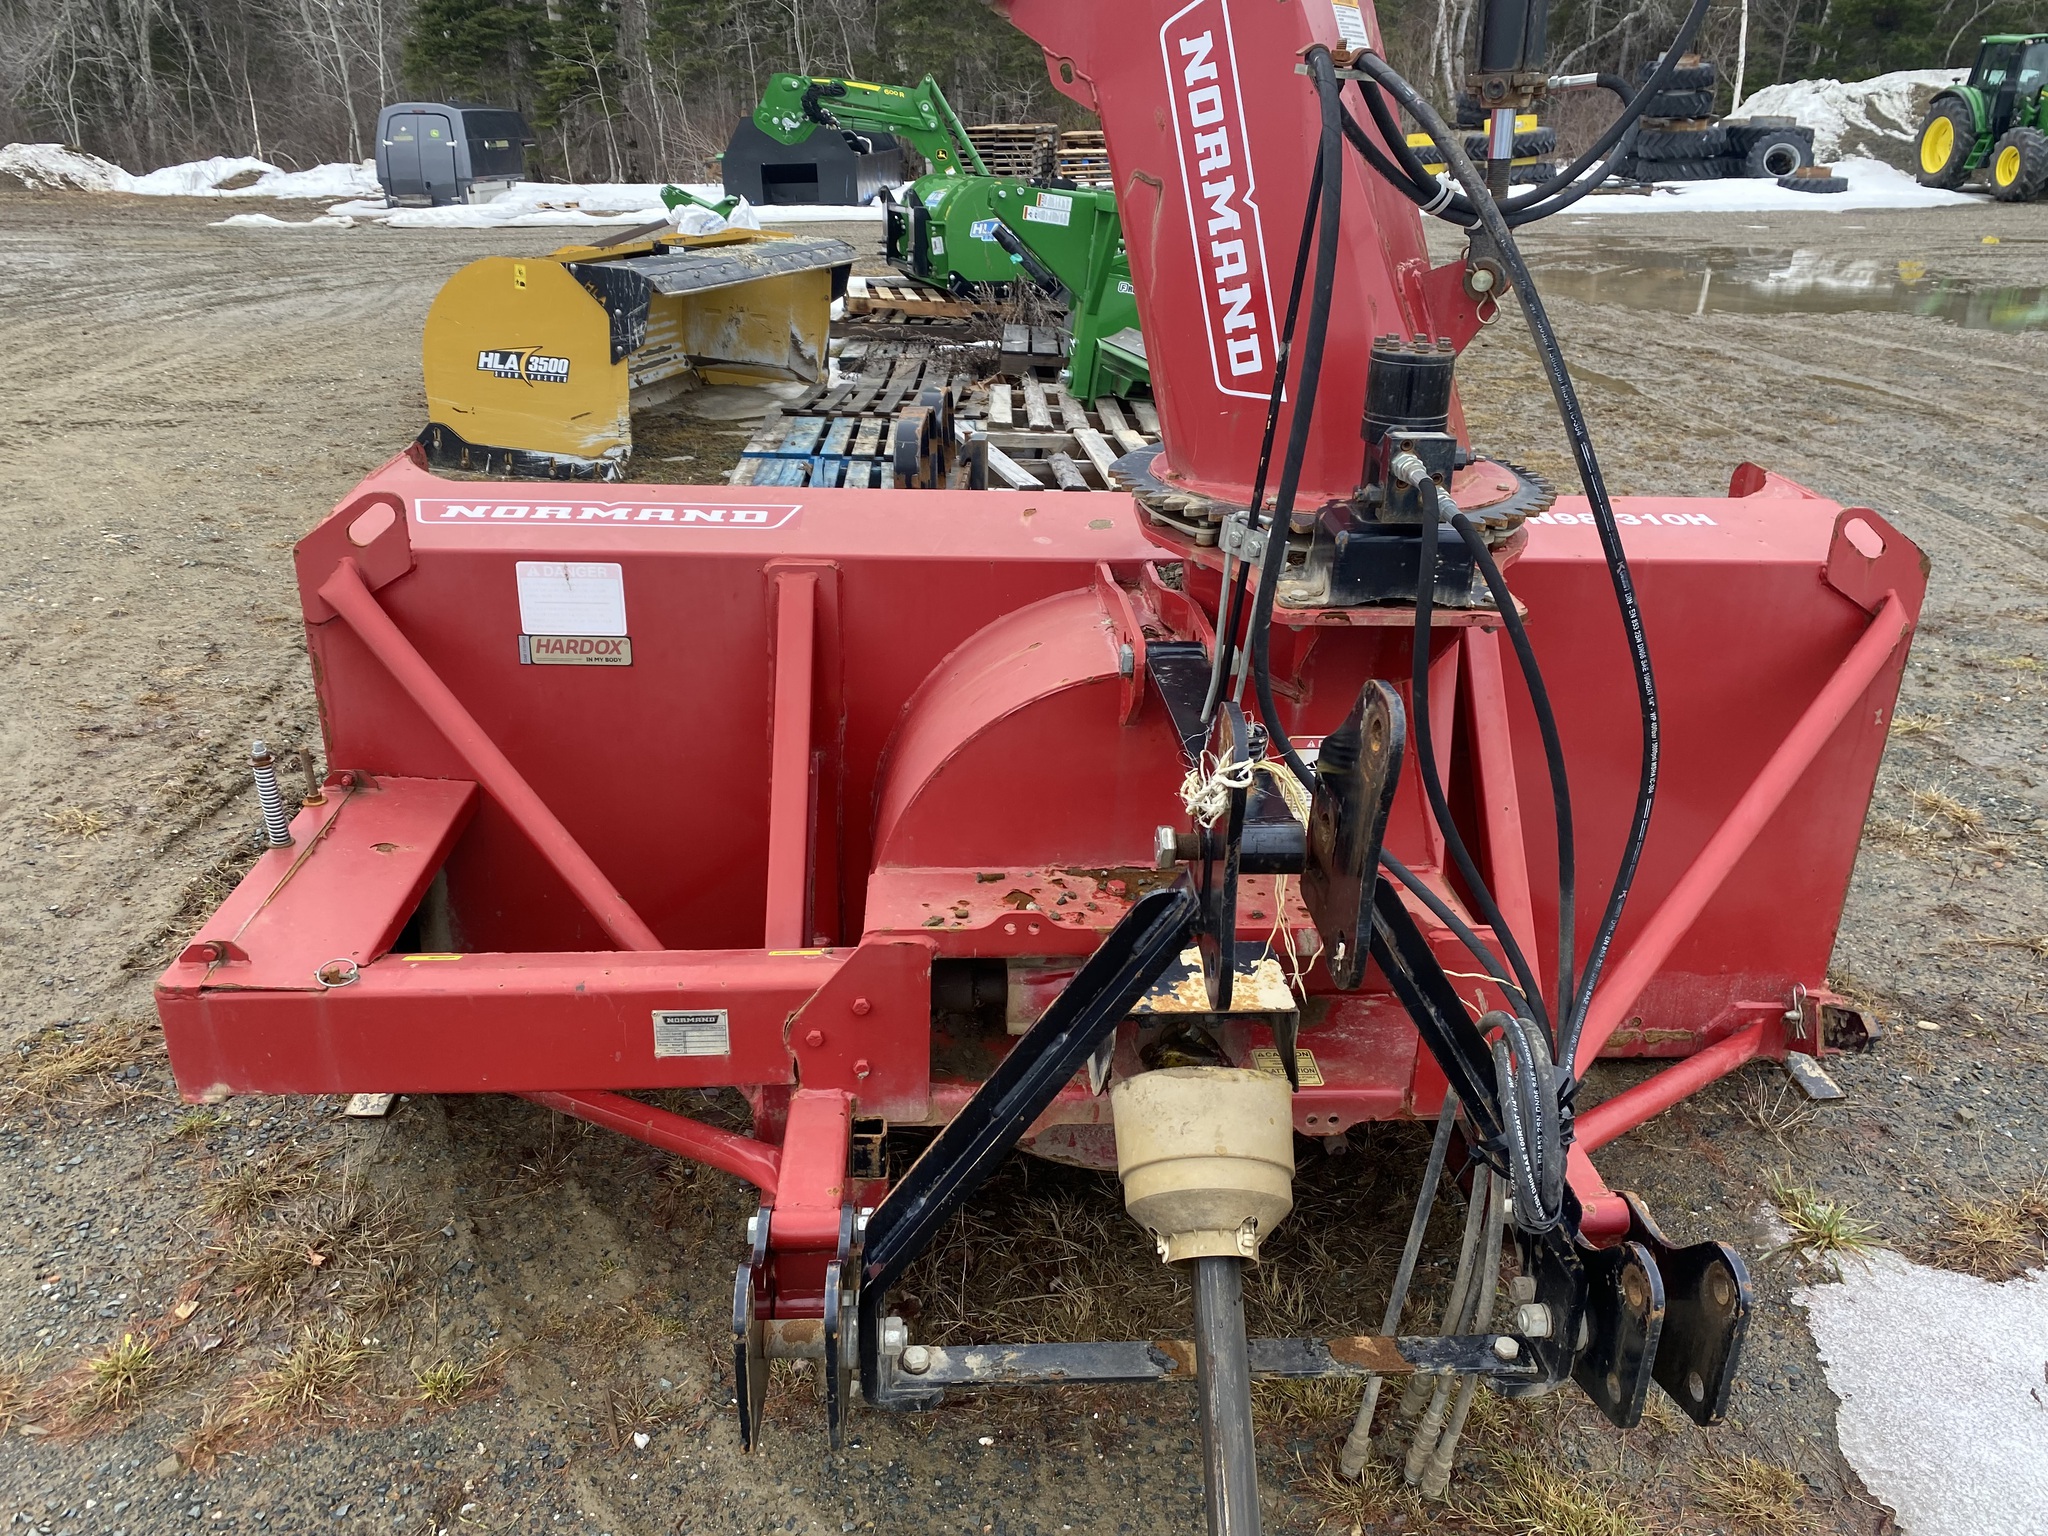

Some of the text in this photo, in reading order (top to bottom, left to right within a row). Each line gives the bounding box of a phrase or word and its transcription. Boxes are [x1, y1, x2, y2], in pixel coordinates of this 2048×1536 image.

[1179, 30, 1263, 377] NORMAND
[478, 352, 569, 373] HLA 3500
[440, 504, 769, 522] NORMAND
[1528, 513, 1718, 526] N98310H
[544, 565, 607, 577] DANGER
[536, 638, 622, 655] HARDOX
[1628, 608, 1637, 618] EN
[1640, 659, 1649, 672] SAE
[1602, 934, 1611, 946] EN
[1513, 1113, 1526, 1151] 100R2AT
[1522, 1153, 1531, 1172] SAE
[1526, 1172, 1537, 1194] DN06
